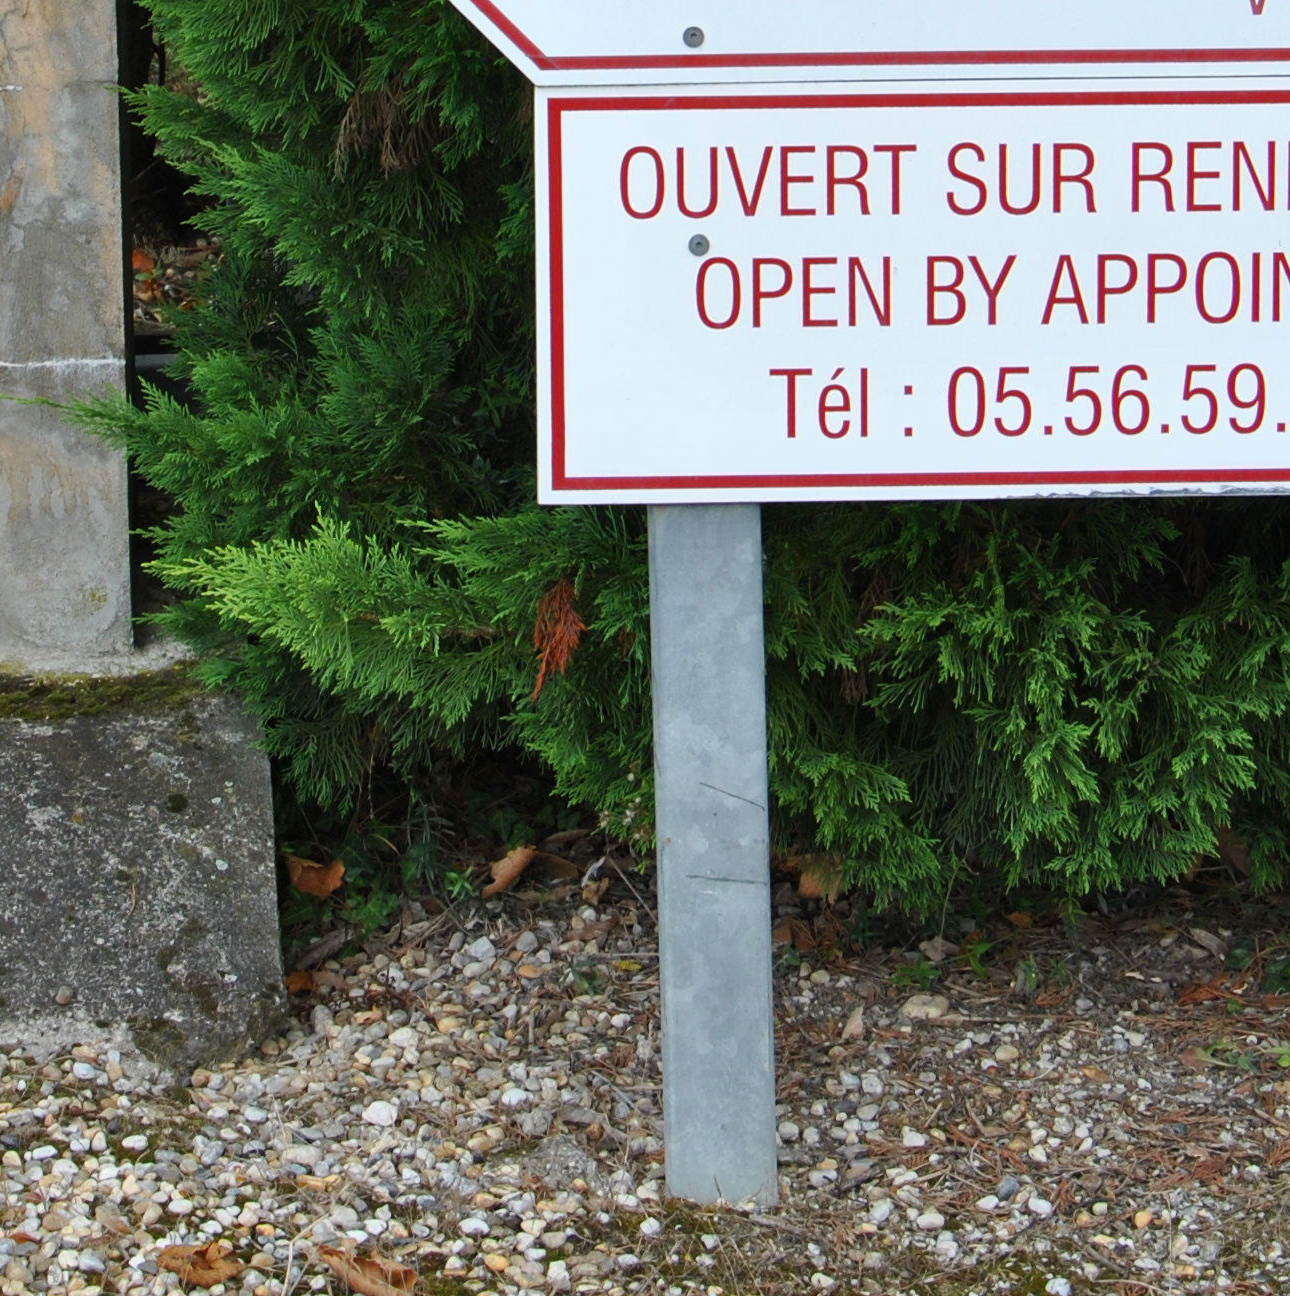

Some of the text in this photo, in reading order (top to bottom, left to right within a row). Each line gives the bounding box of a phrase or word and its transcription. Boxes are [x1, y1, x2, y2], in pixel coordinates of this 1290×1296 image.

[619, 143, 918, 220] OUVERT
[947, 141, 1097, 216] SUR
[695, 255, 892, 330] OPEN
[927, 254, 1018, 327] BY
[769, 367, 869, 439] Tél
